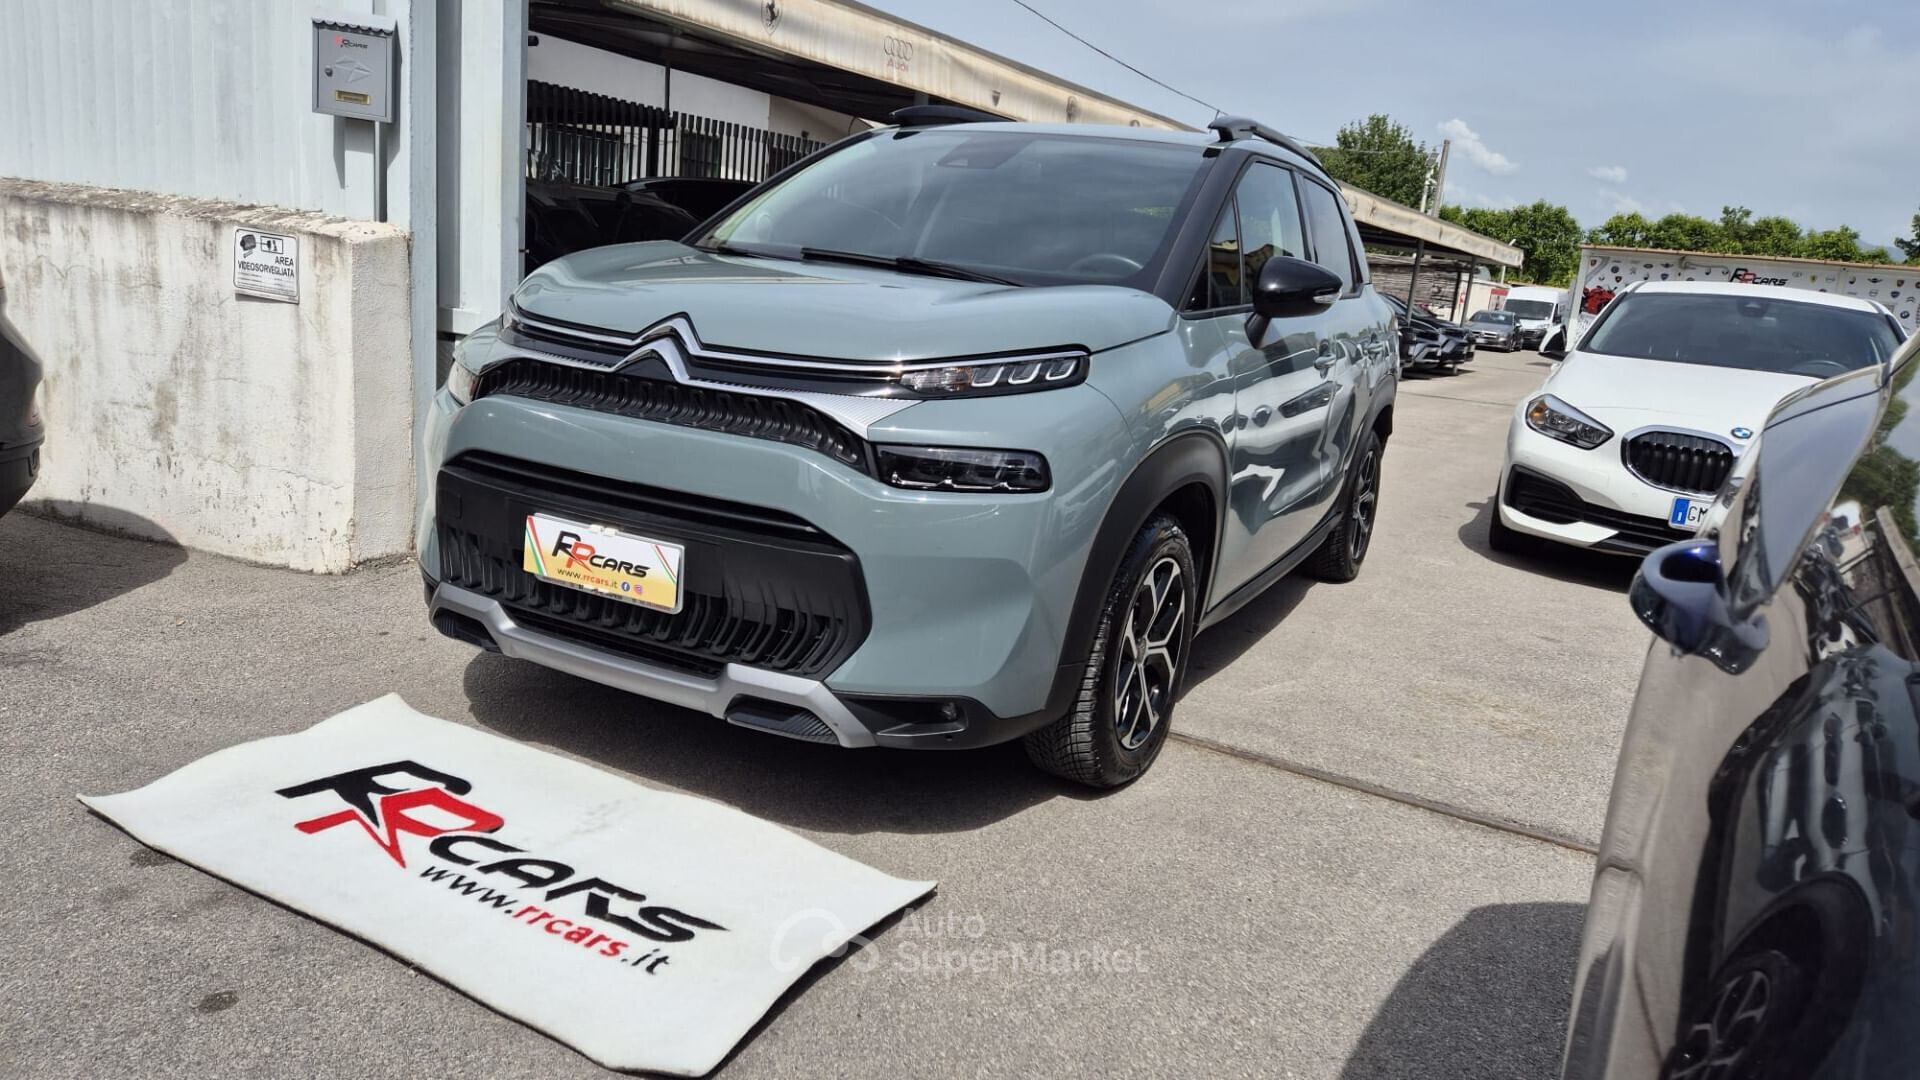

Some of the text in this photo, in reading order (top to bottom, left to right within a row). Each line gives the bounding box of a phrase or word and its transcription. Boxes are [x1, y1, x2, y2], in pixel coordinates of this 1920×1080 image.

[238, 260, 295, 278] VIDEOSORVEGLIATA
[275, 256, 294, 266] AREA
[557, 568, 618, 589] www.rrcars.it
[420, 866, 671, 976] www.rrcars.it
